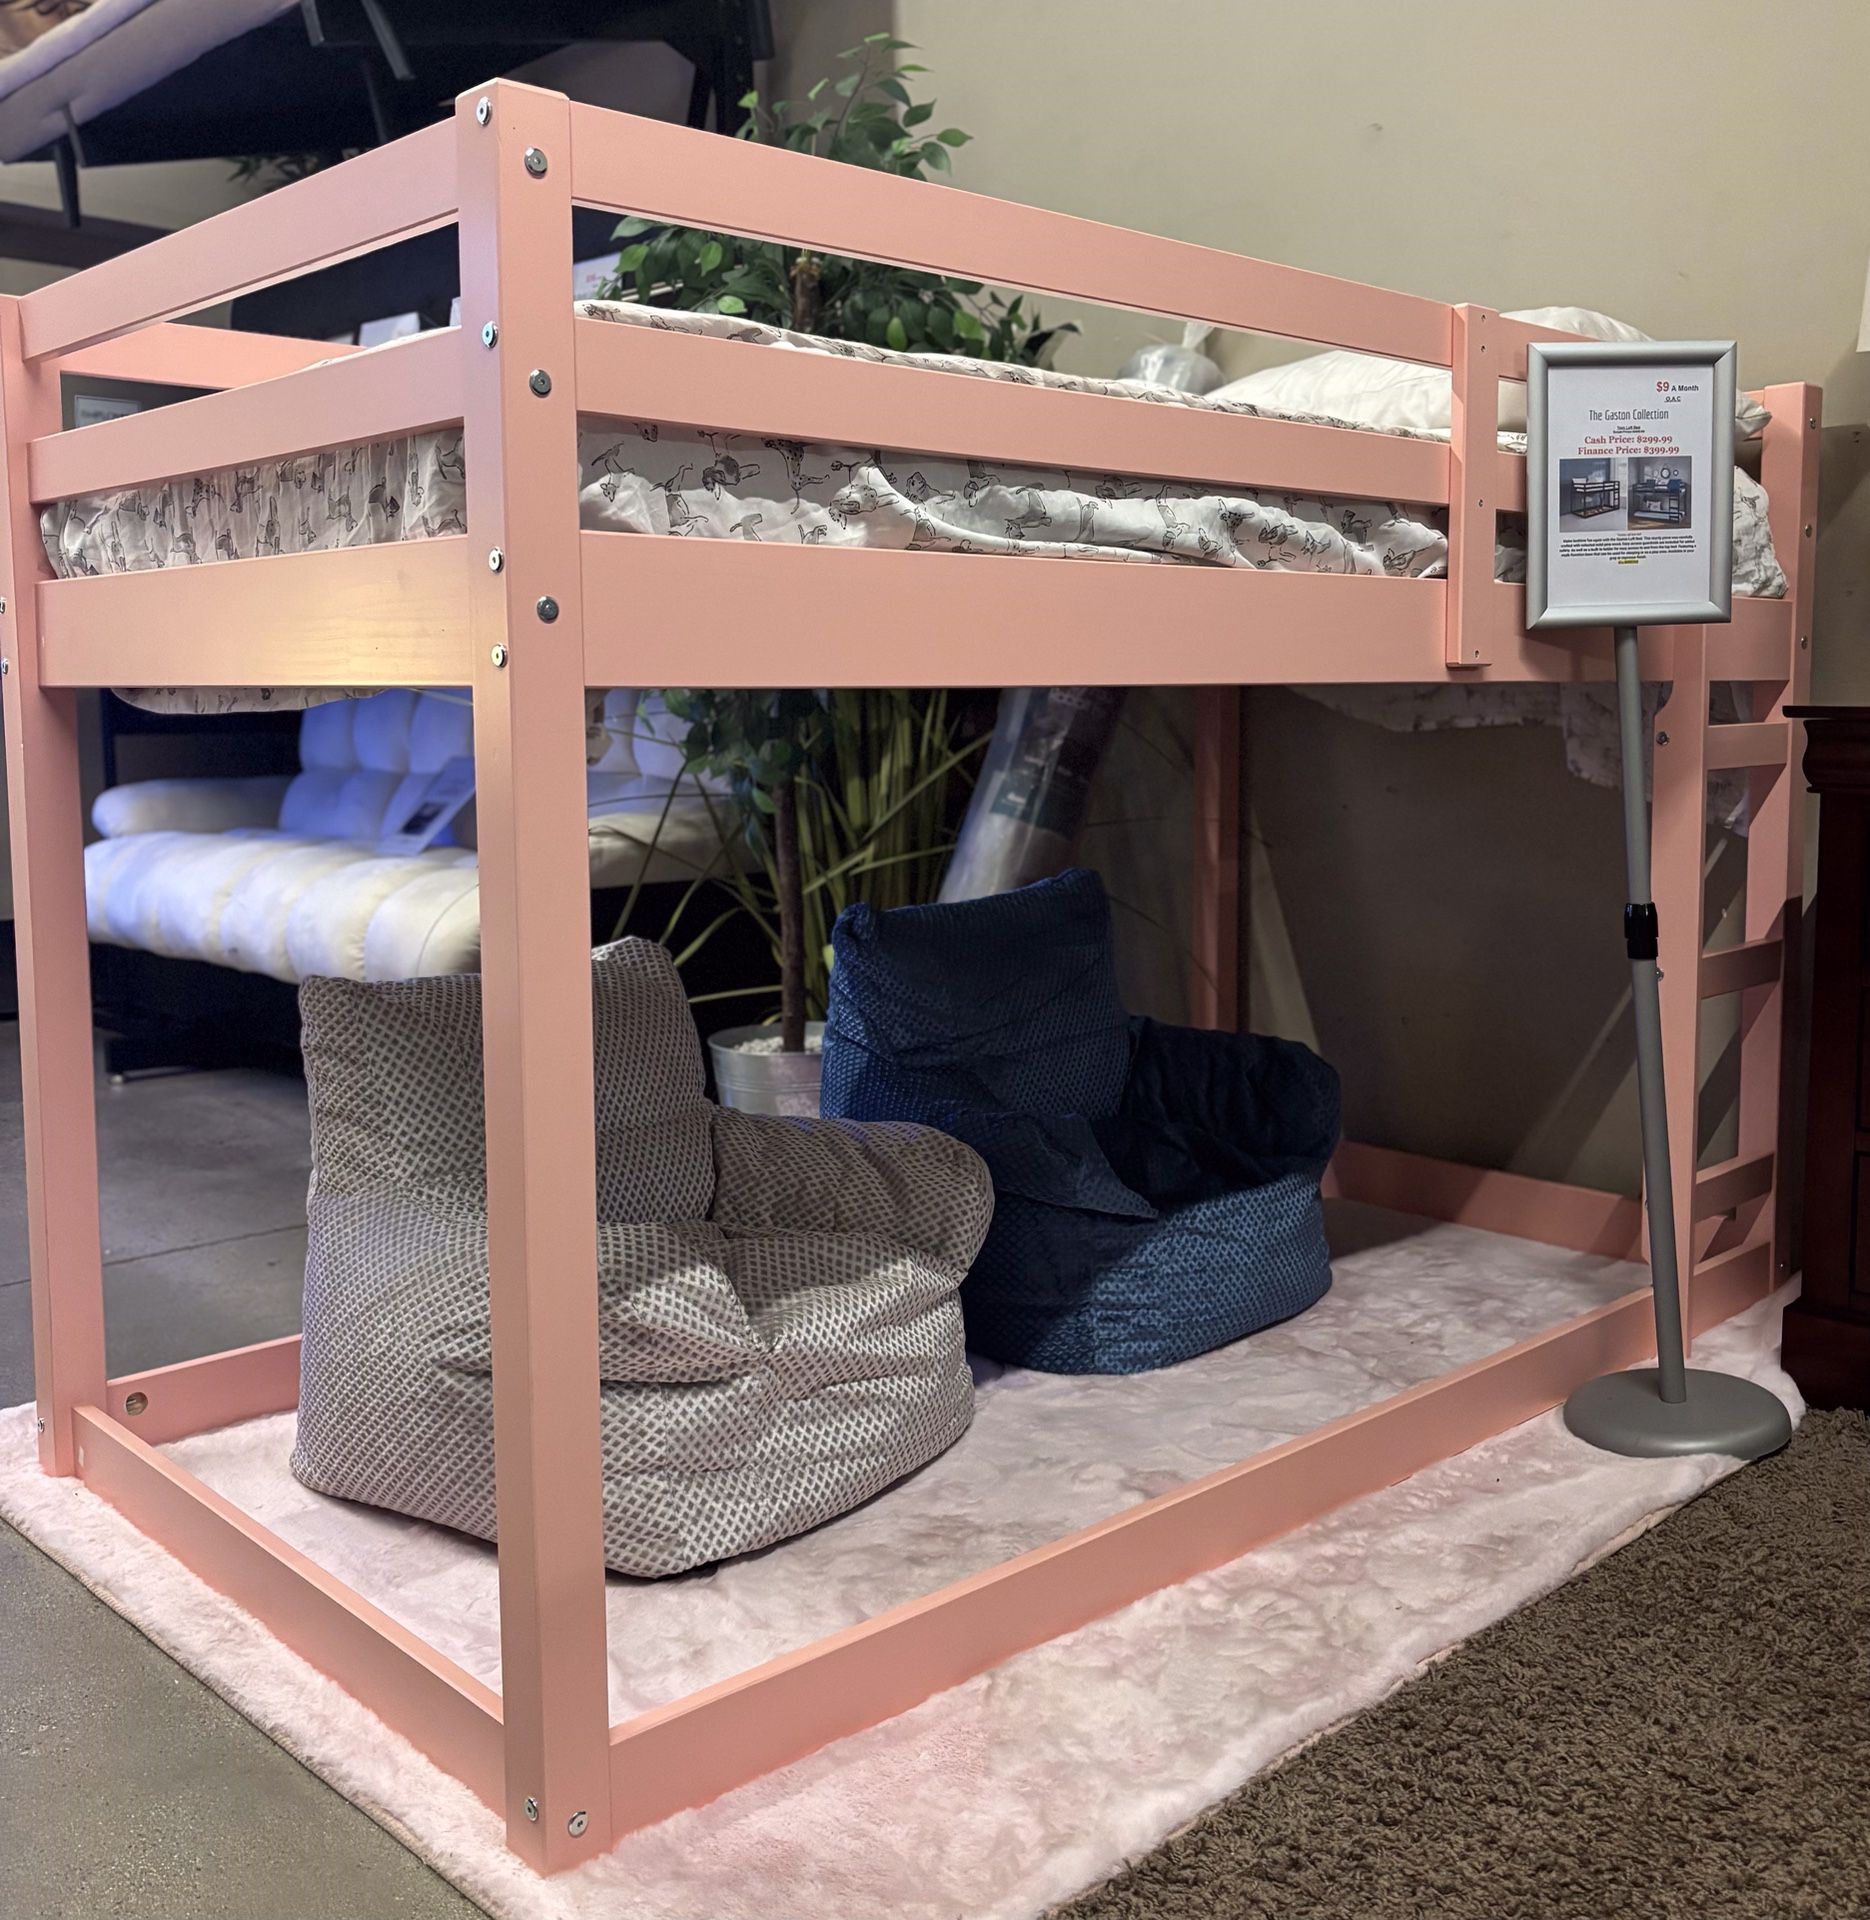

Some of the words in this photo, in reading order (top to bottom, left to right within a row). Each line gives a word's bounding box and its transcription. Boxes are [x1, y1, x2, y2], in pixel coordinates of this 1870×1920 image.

[1656, 381, 1670, 393] $9
[1589, 410, 1602, 421] The
[1605, 409, 1630, 420] Gaston
[1632, 408, 1669, 420] Collection
[1584, 435, 1606, 444] Cash
[1609, 435, 1634, 444] Price:
[1636, 435, 1673, 444] $299.99
[1578, 447, 1613, 455] Finance
[1615, 446, 1641, 454] Price:
[1643, 446, 1680, 454] $399.99
